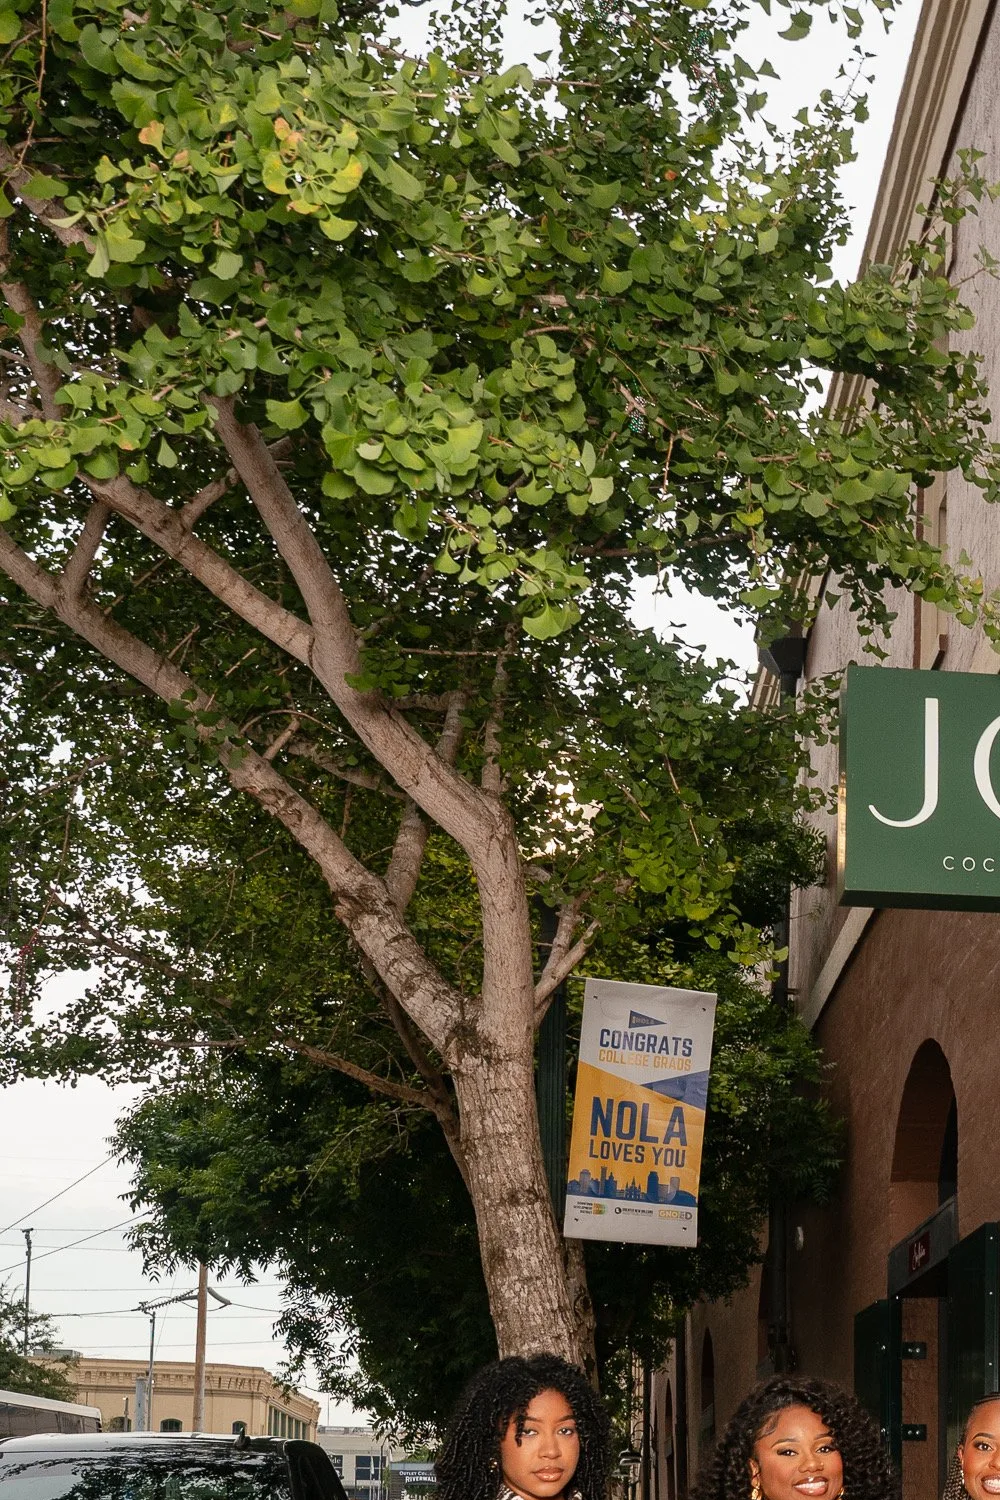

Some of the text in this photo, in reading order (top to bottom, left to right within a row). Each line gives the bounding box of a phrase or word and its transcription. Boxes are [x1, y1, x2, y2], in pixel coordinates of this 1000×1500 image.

[600, 1028, 693, 1057] CONGRATS
[598, 1048, 692, 1071] COLLEGE GRADS
[590, 1096, 688, 1147] NOLA
[588, 1139, 686, 1168] LOVES YOU
[405, 1475, 437, 1483] RIVERWAL
